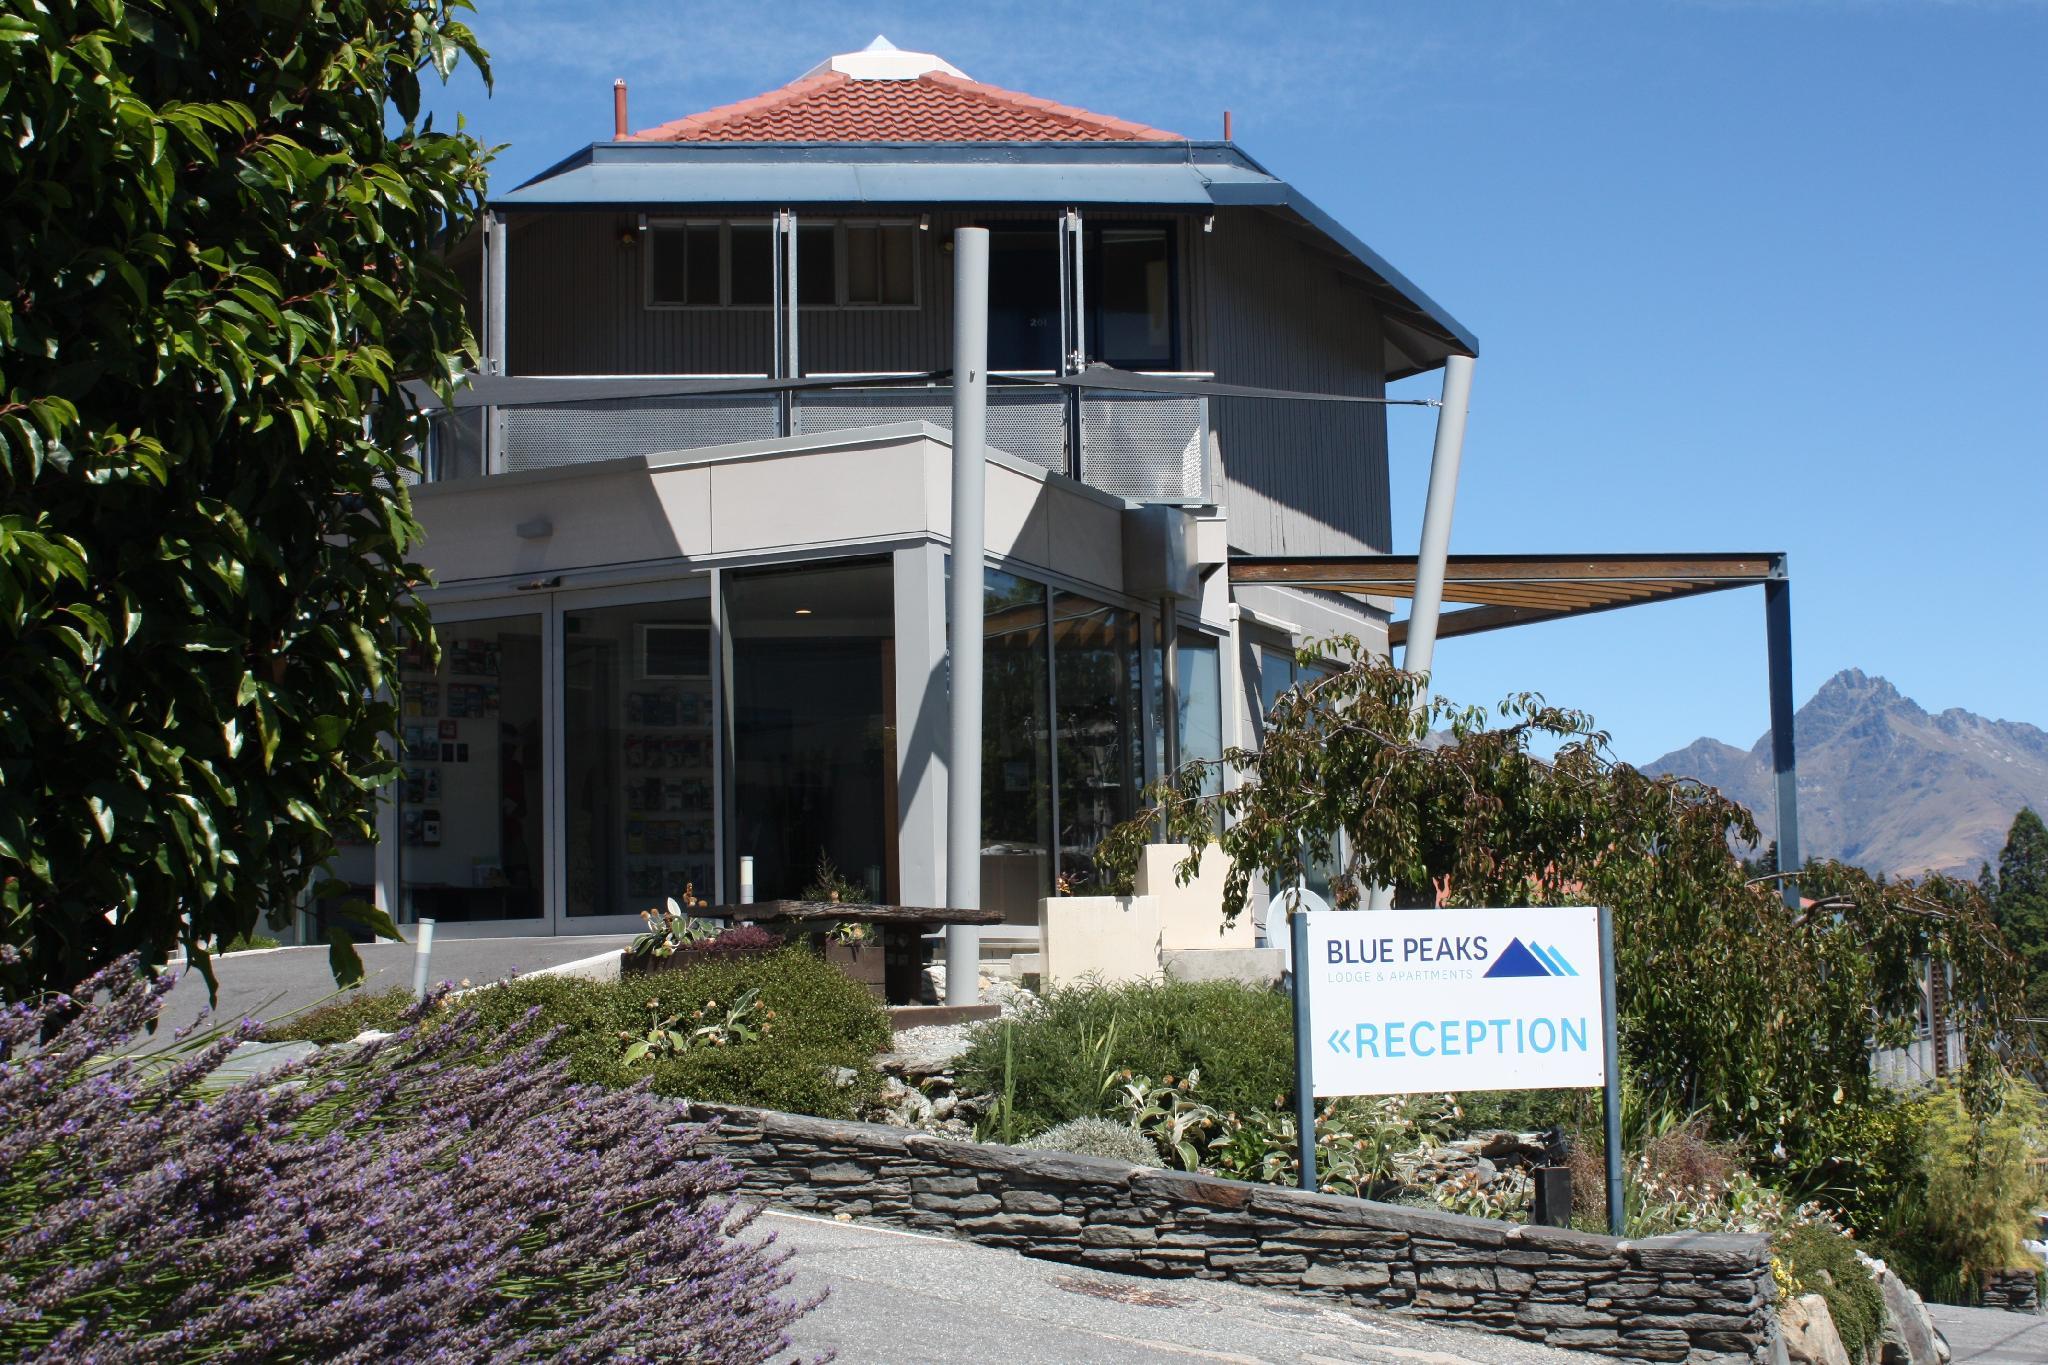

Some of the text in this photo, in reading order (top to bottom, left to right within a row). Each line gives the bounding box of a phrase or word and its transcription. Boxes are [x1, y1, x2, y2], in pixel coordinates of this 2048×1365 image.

[1327, 935, 1489, 964] BLUE PEAKS
[1327, 969, 1474, 983] LODGE & APARTMENTS
[1355, 1016, 1588, 1058] RECEPTION
